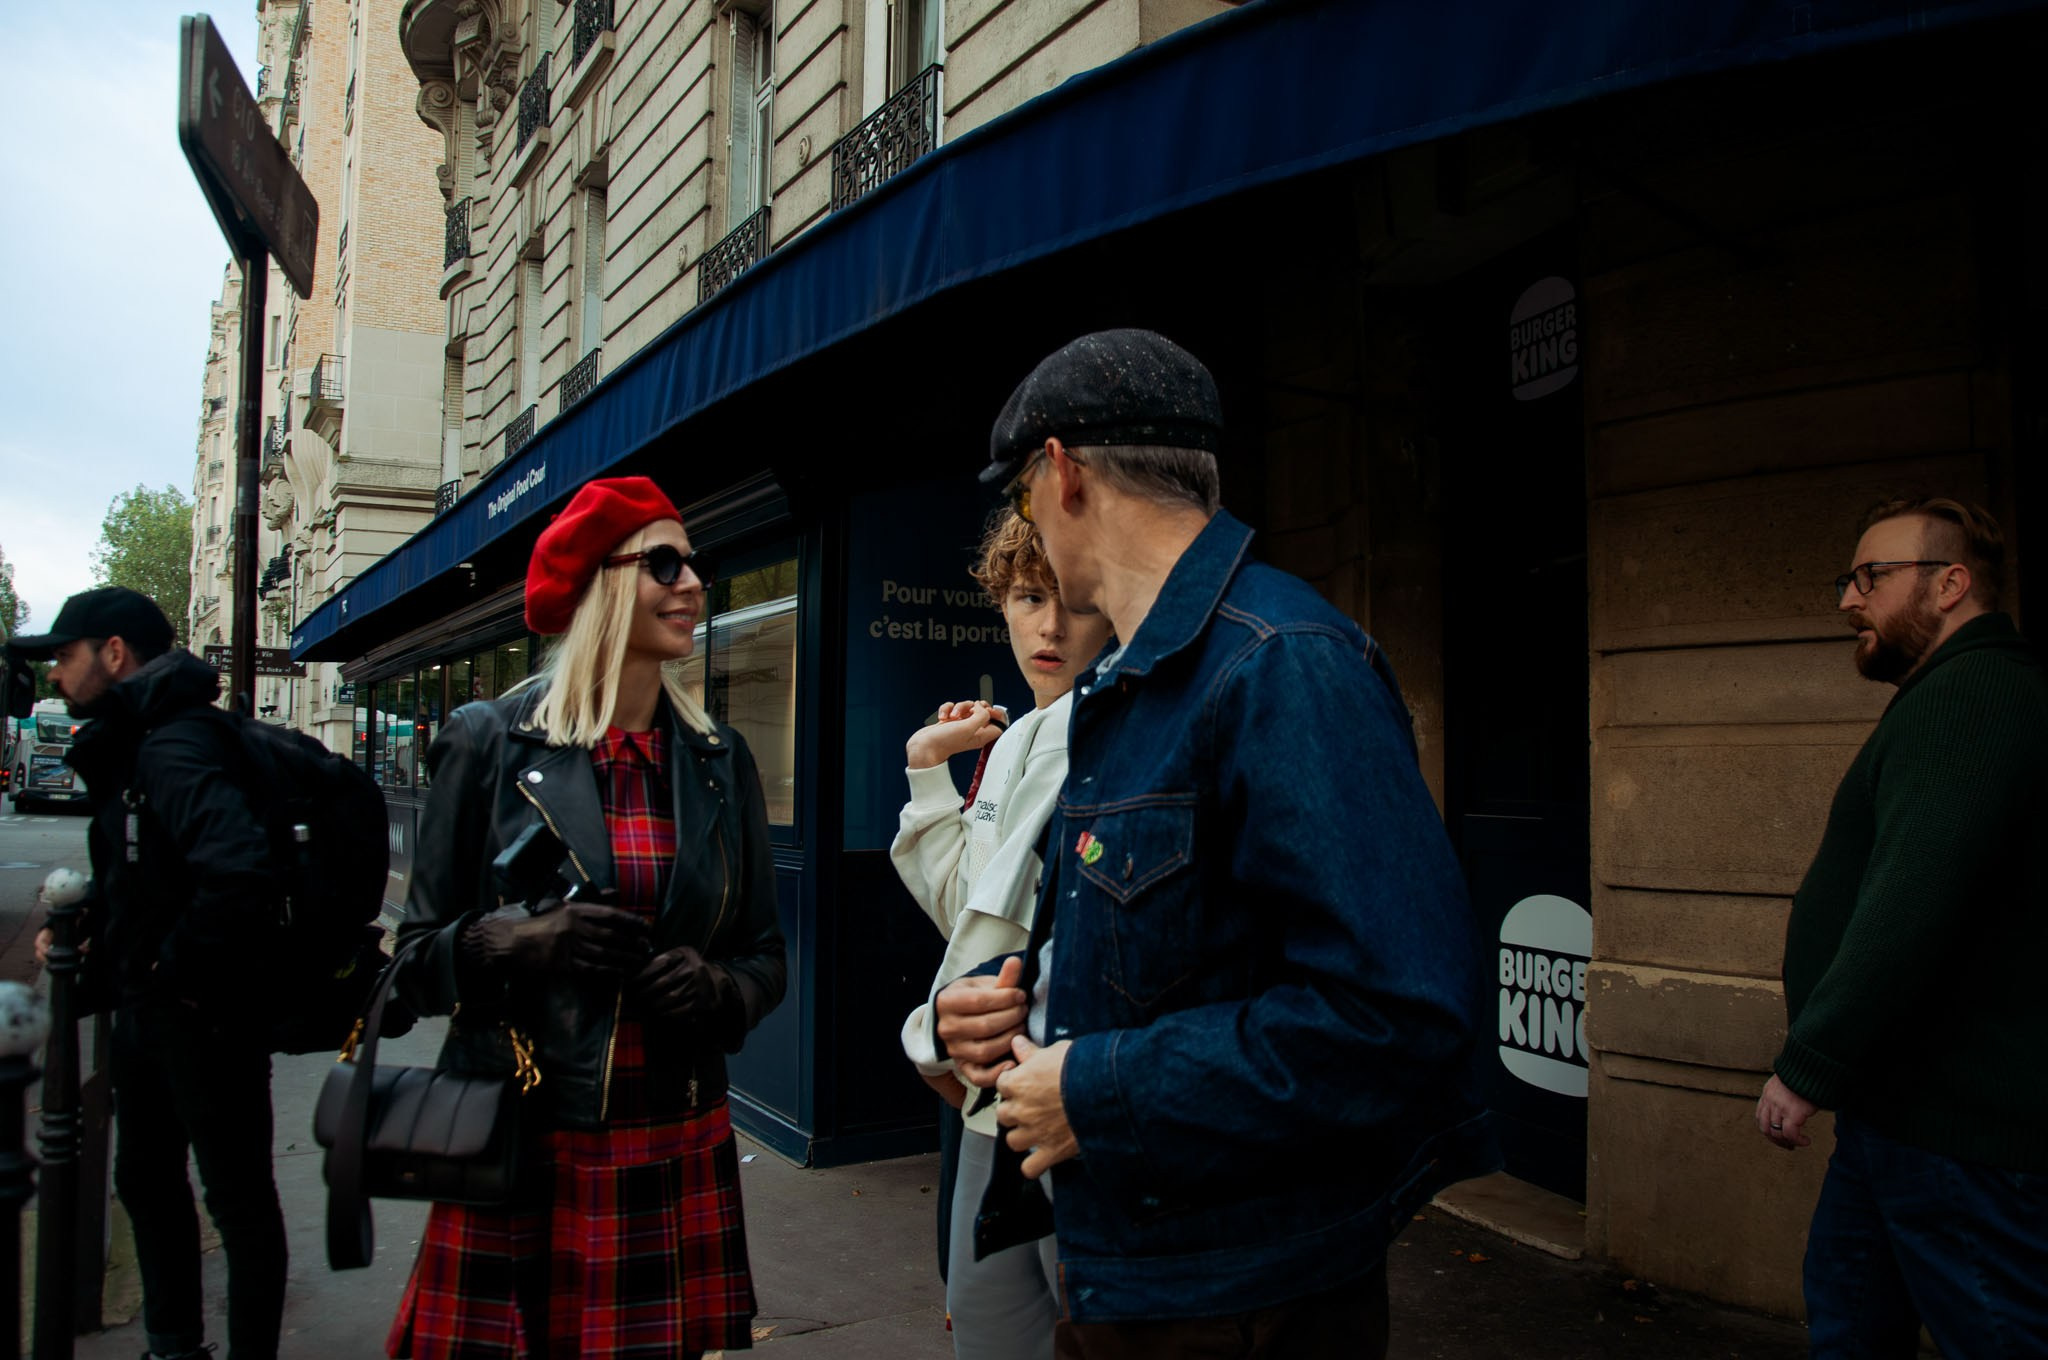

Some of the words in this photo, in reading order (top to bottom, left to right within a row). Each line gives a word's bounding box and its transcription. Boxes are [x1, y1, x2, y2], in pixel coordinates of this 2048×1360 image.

[1510, 303, 1577, 352] BURGER
[1511, 328, 1578, 385] KING
[516, 472, 530, 499] Food
[530, 461, 546, 489] Court
[882, 580, 936, 605] Pour
[942, 588, 993, 608] vous
[869, 615, 923, 639] c'est
[928, 618, 947, 640] la
[952, 624, 1010, 648] porte
[1499, 948, 1586, 1002] BURGE
